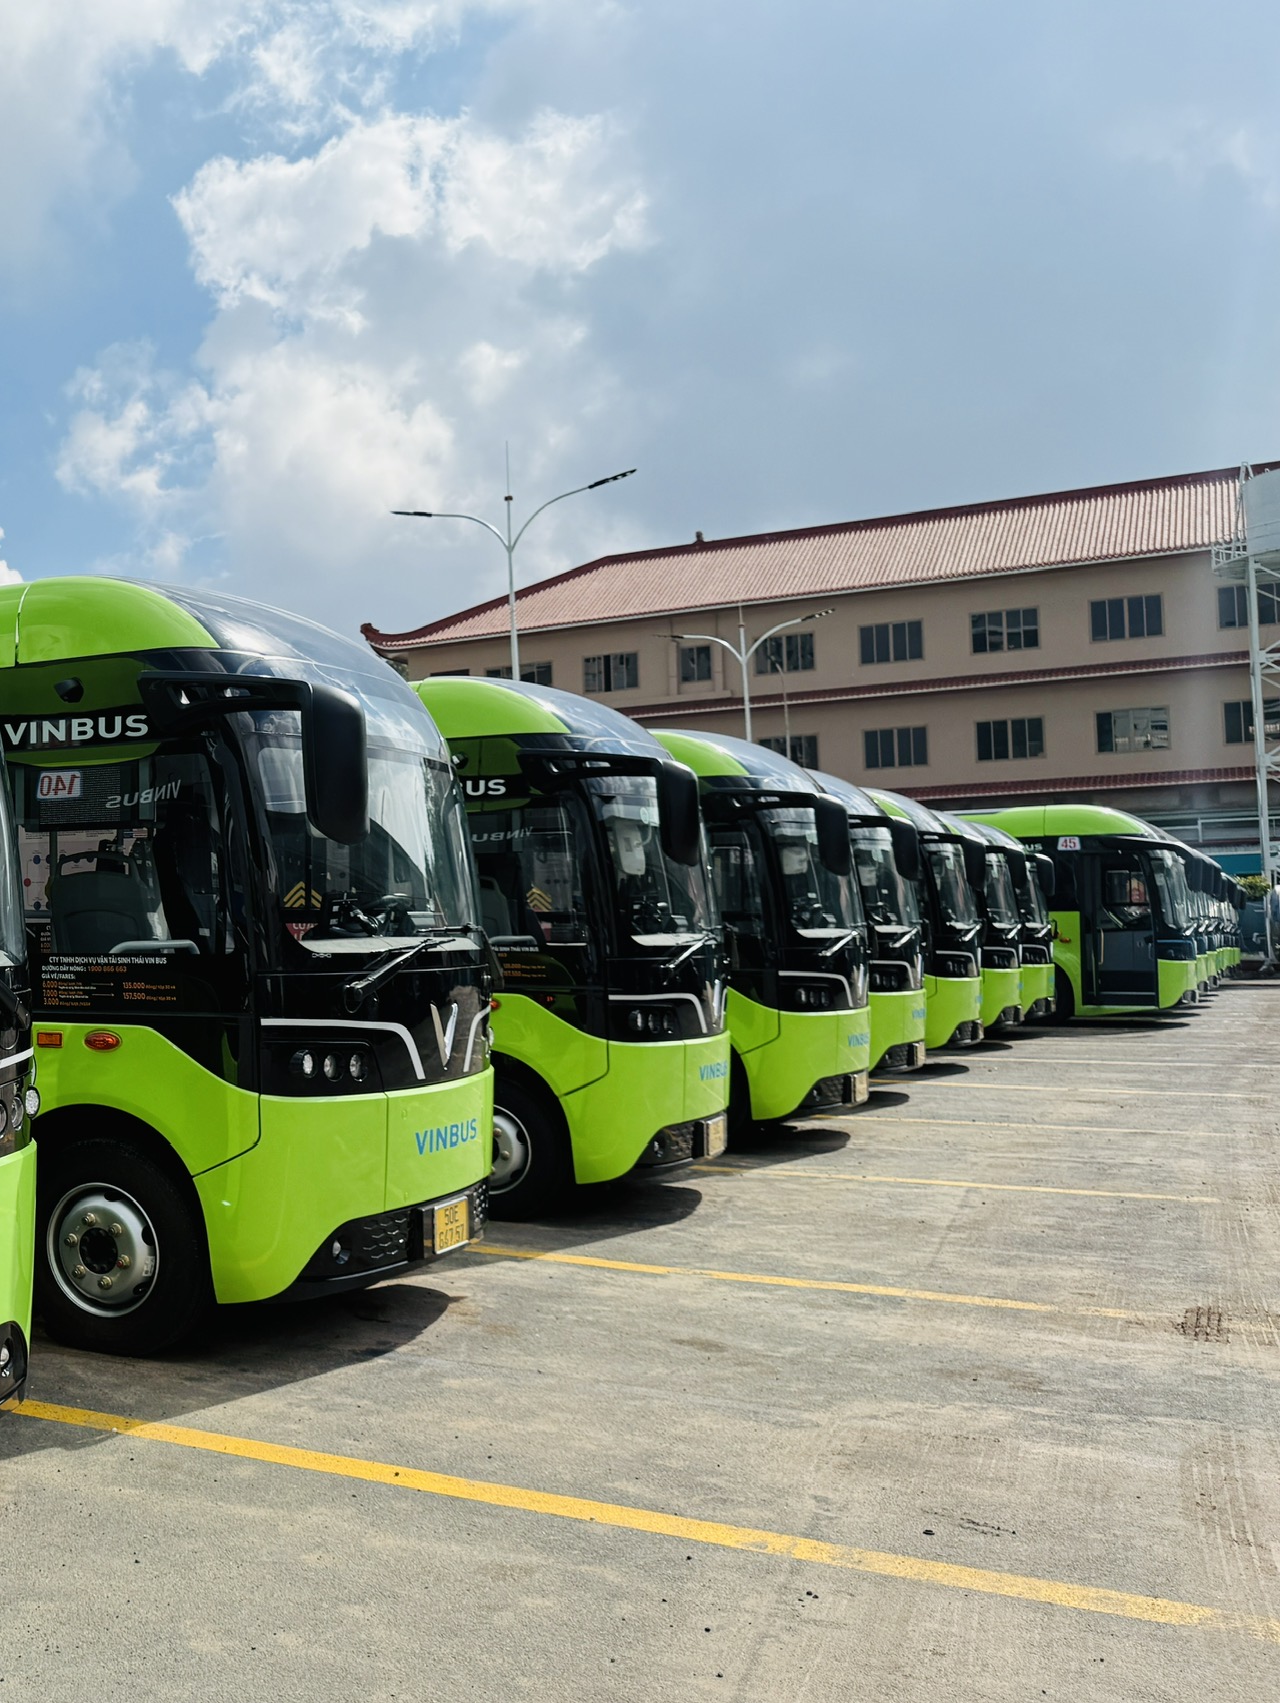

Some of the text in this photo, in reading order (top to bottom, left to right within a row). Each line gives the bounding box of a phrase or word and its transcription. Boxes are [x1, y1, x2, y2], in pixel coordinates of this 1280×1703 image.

[4, 714, 149, 746] VINBUS
[1061, 838, 1077, 848] 45
[415, 1118, 478, 1155] VINBUS
